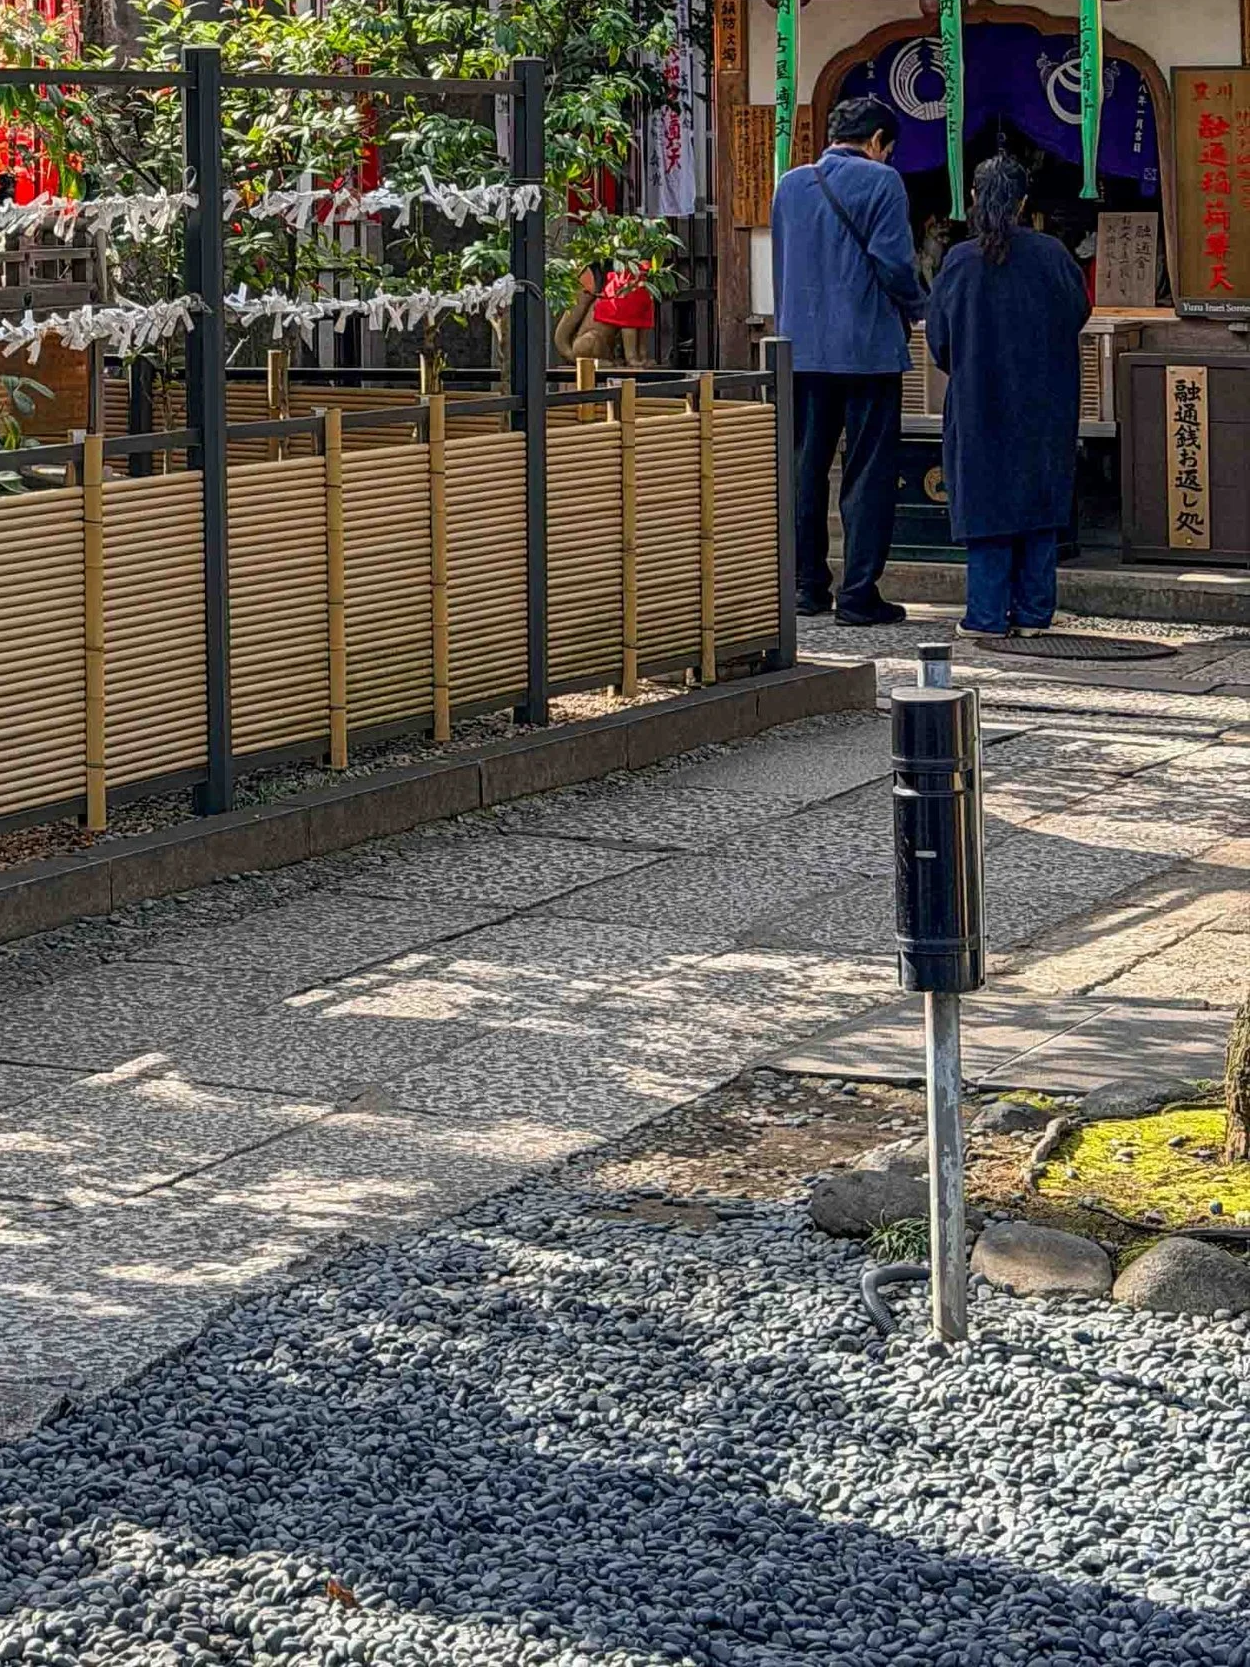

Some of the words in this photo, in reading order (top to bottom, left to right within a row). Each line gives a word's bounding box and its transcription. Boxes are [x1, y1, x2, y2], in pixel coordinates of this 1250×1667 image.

[1173, 379, 1205, 536] 融通銭お返し処
